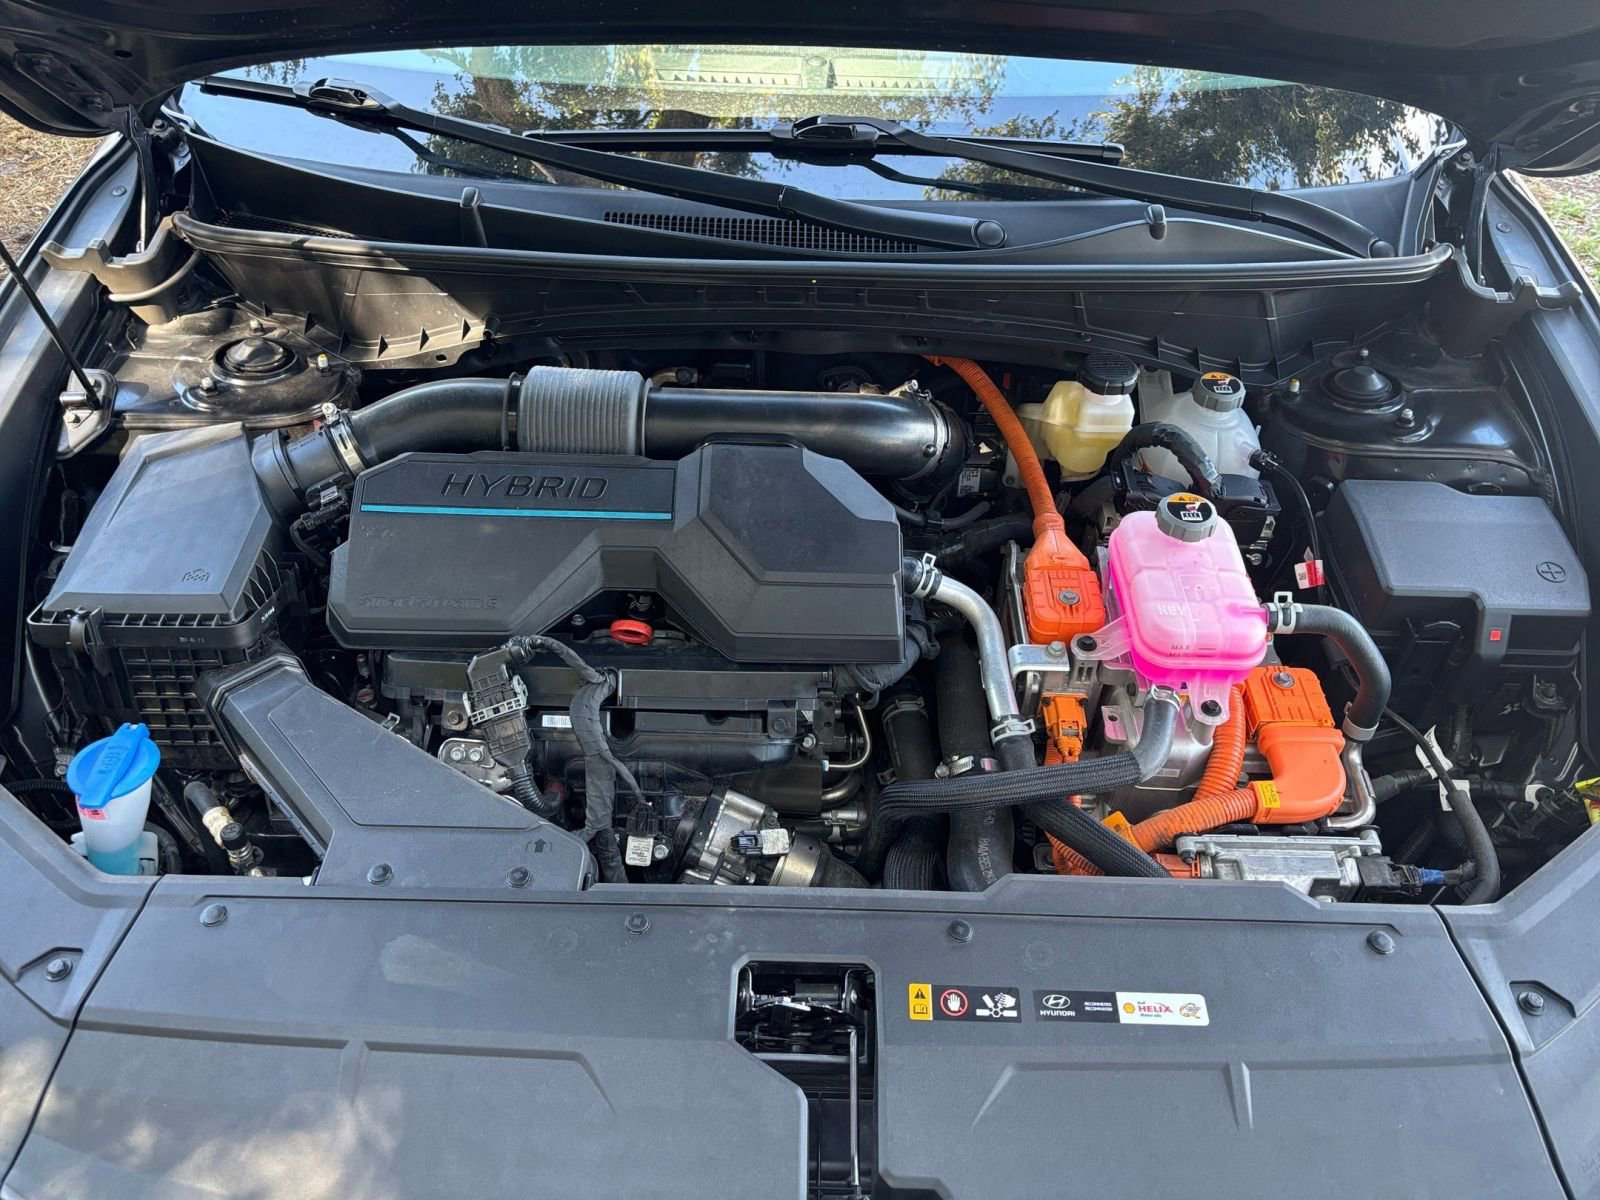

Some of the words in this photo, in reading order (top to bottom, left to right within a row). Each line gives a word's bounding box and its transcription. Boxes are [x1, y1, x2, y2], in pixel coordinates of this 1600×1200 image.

[440, 473, 609, 499] HYBRID
[1040, 1009, 1076, 1017] HYUNDAI
[1138, 1004, 1174, 1014] HELIX
